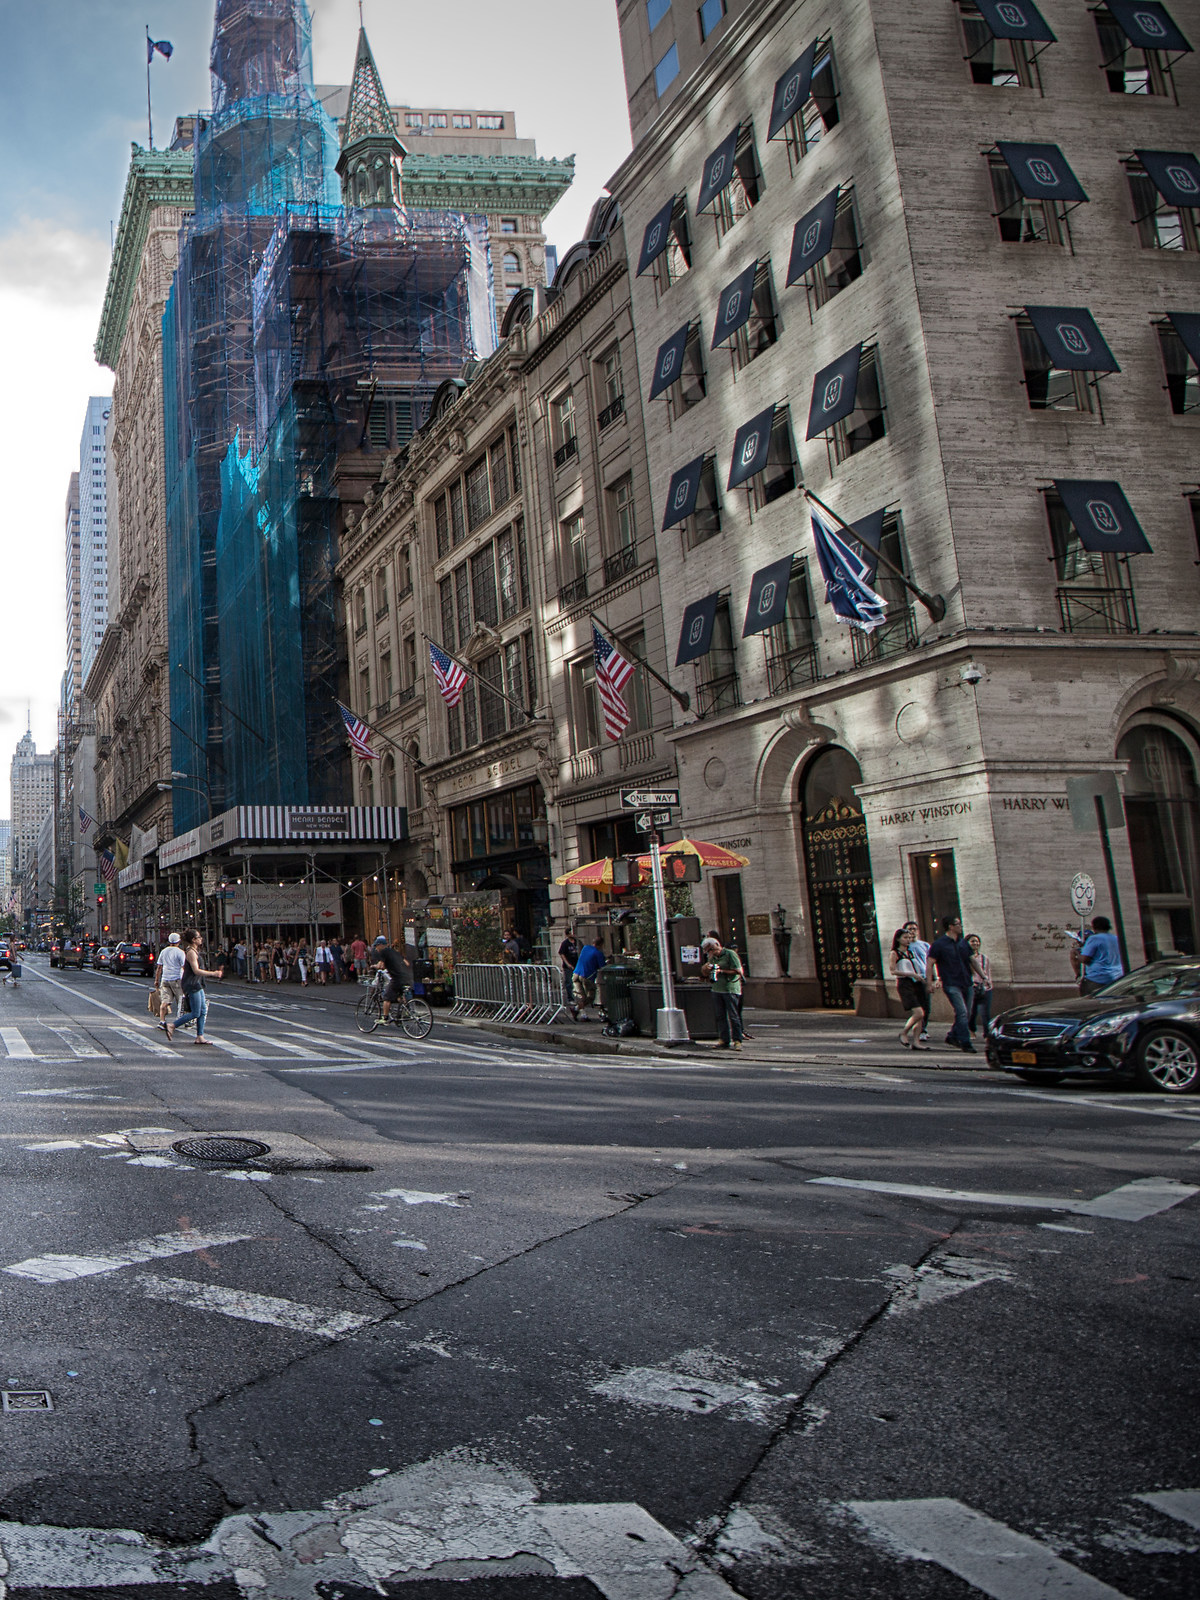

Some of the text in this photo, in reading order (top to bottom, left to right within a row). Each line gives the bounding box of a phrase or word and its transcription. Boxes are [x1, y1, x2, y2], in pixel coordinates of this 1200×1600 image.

[487, 756, 521, 778] BENDEL
[630, 794, 673, 803] ONE WAY
[1003, 797, 1048, 811] HARRY
[880, 801, 973, 826] HARRY WINSTON
[718, 837, 752, 850] WINSTON
